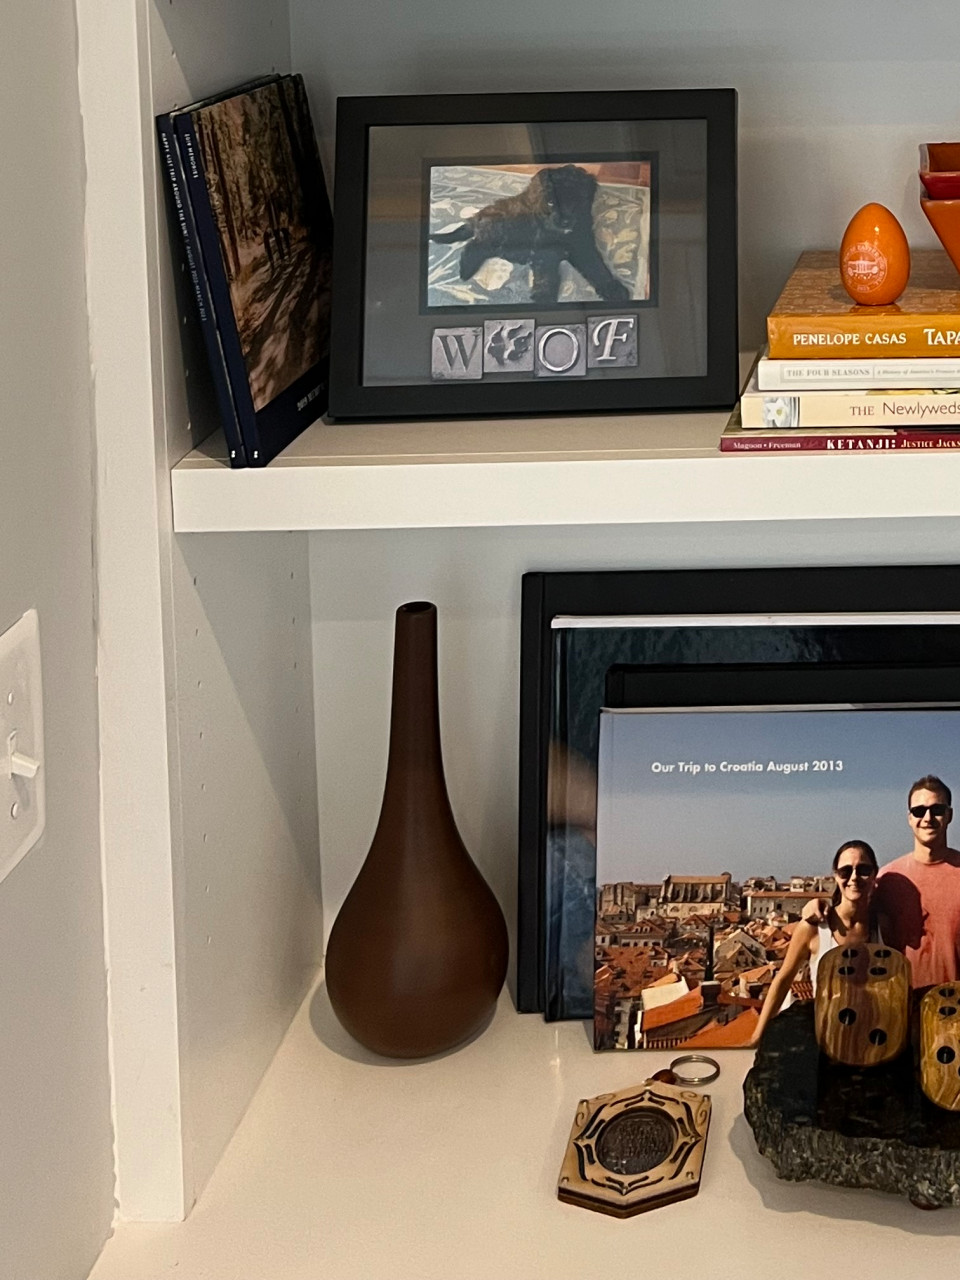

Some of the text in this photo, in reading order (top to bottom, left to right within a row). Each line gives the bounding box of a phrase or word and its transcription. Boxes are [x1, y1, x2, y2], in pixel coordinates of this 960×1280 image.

[793, 332, 907, 346] PENELOPE CASAS
[786, 368, 870, 377] THE FOUR SEASONS
[850, 405, 875, 416] THE
[732, 441, 801, 450] Magoon Freeman
[826, 438, 897, 450] KETANJI:
[651, 760, 844, 775] Our Trip to Croatia August 2013
